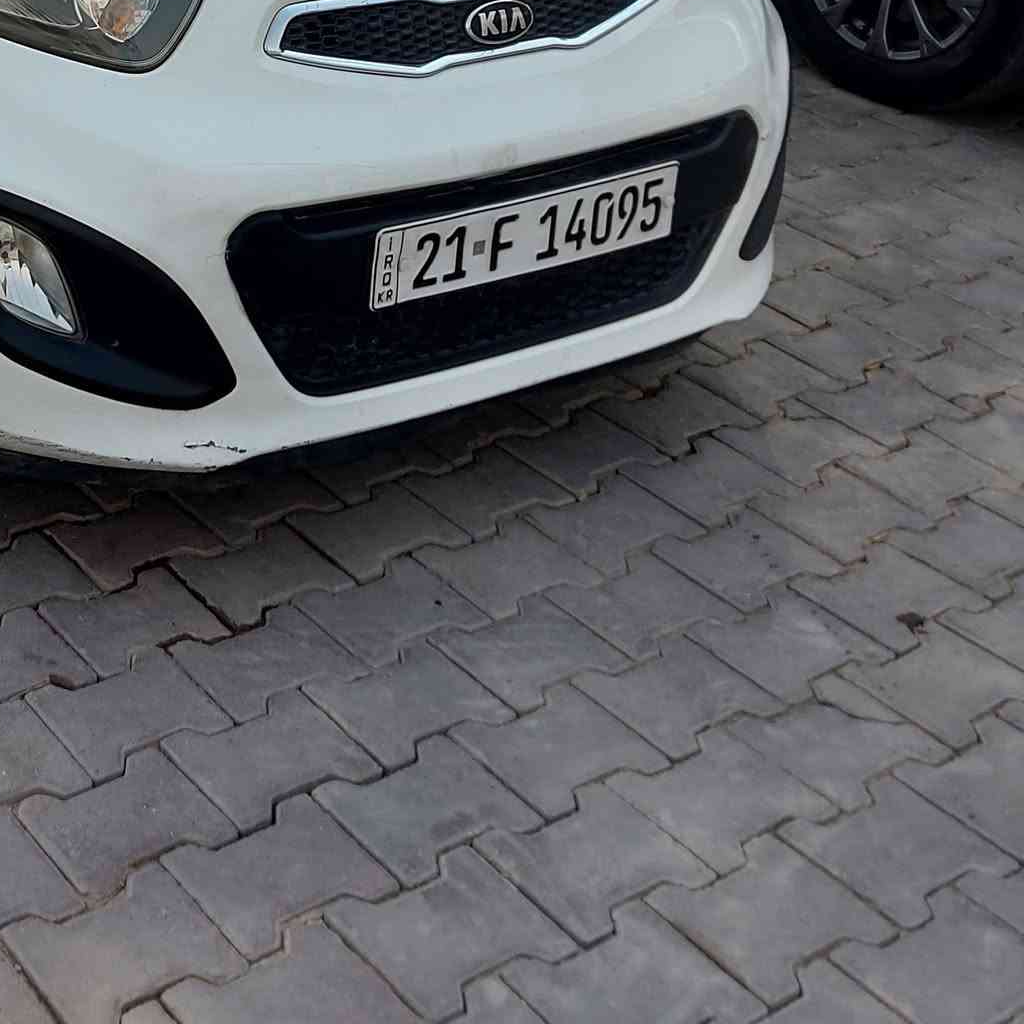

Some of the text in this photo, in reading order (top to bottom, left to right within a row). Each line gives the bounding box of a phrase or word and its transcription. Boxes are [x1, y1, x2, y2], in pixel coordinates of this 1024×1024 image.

[477, 6, 527, 37] KIA
[412, 177, 665, 290] 21 F 14095
